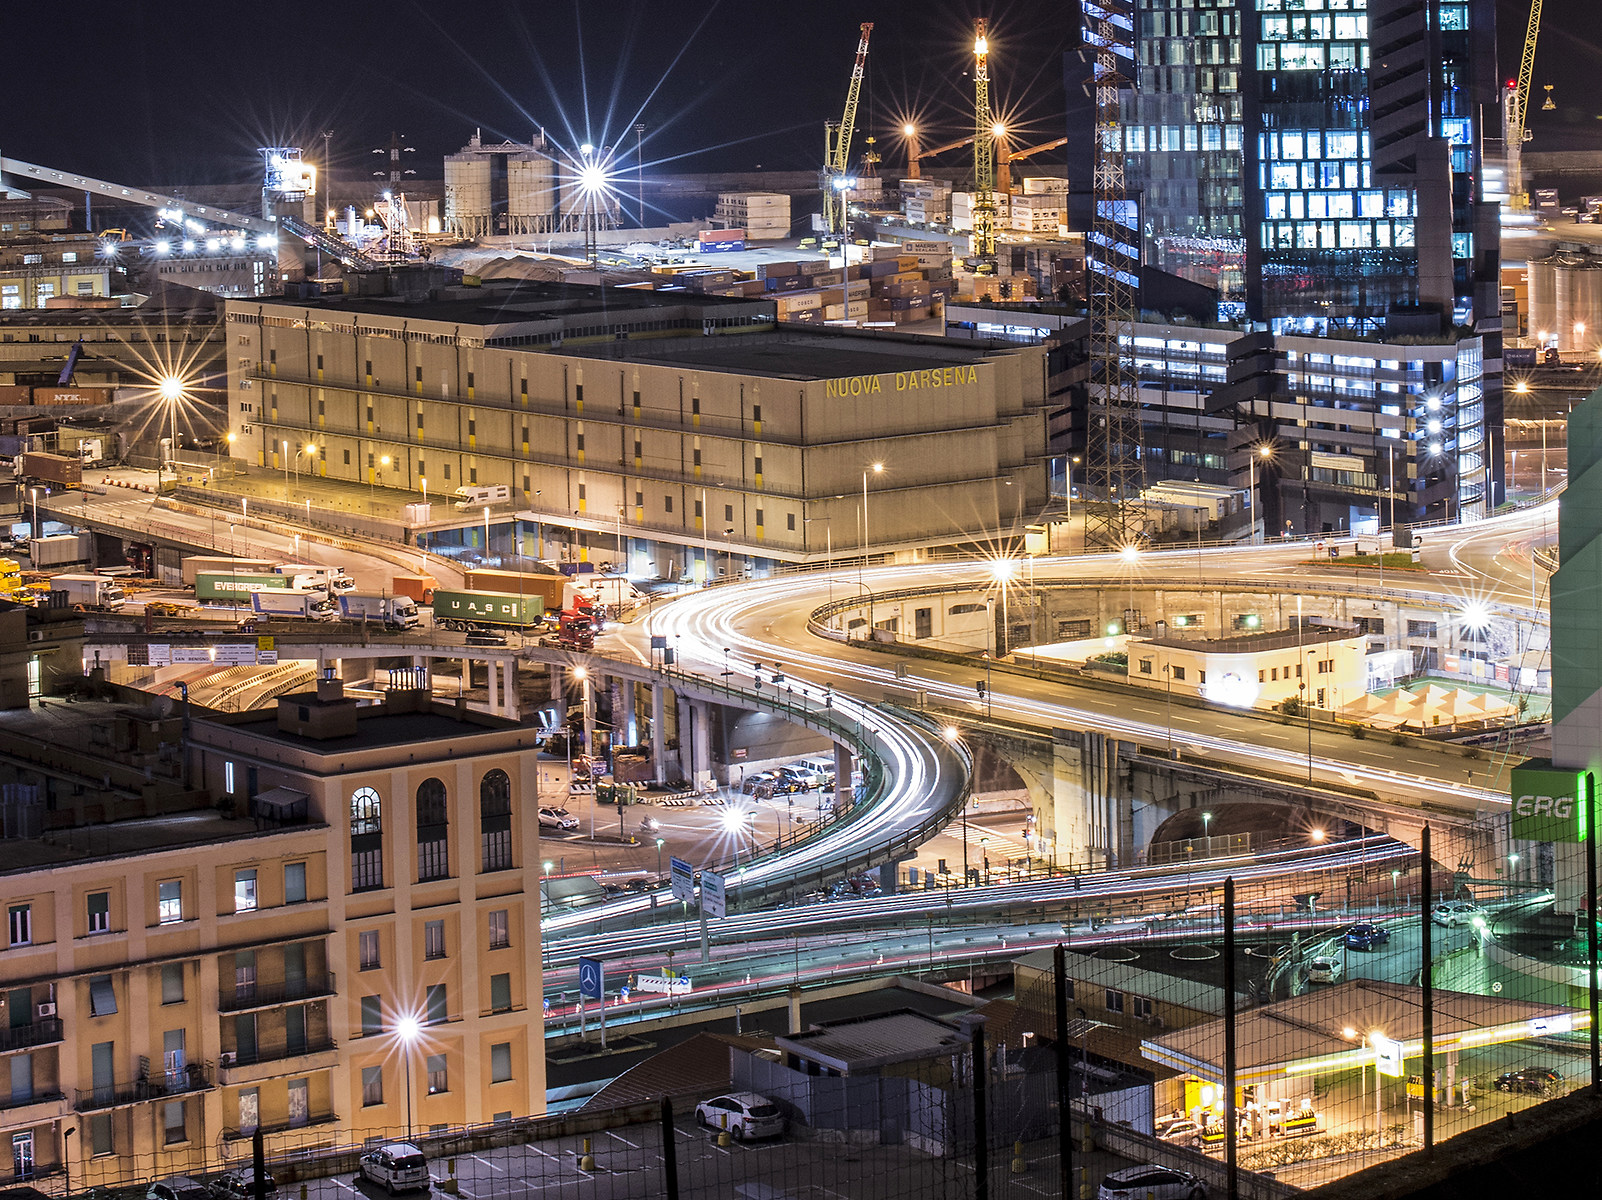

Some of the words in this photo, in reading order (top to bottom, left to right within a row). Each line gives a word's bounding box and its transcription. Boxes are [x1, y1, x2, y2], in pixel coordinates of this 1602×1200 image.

[826, 375, 881, 398] NUOVA
[896, 365, 978, 391] DARSENA
[214, 581, 268, 592] EVERGREEN
[1516, 794, 1574, 819] ERG
